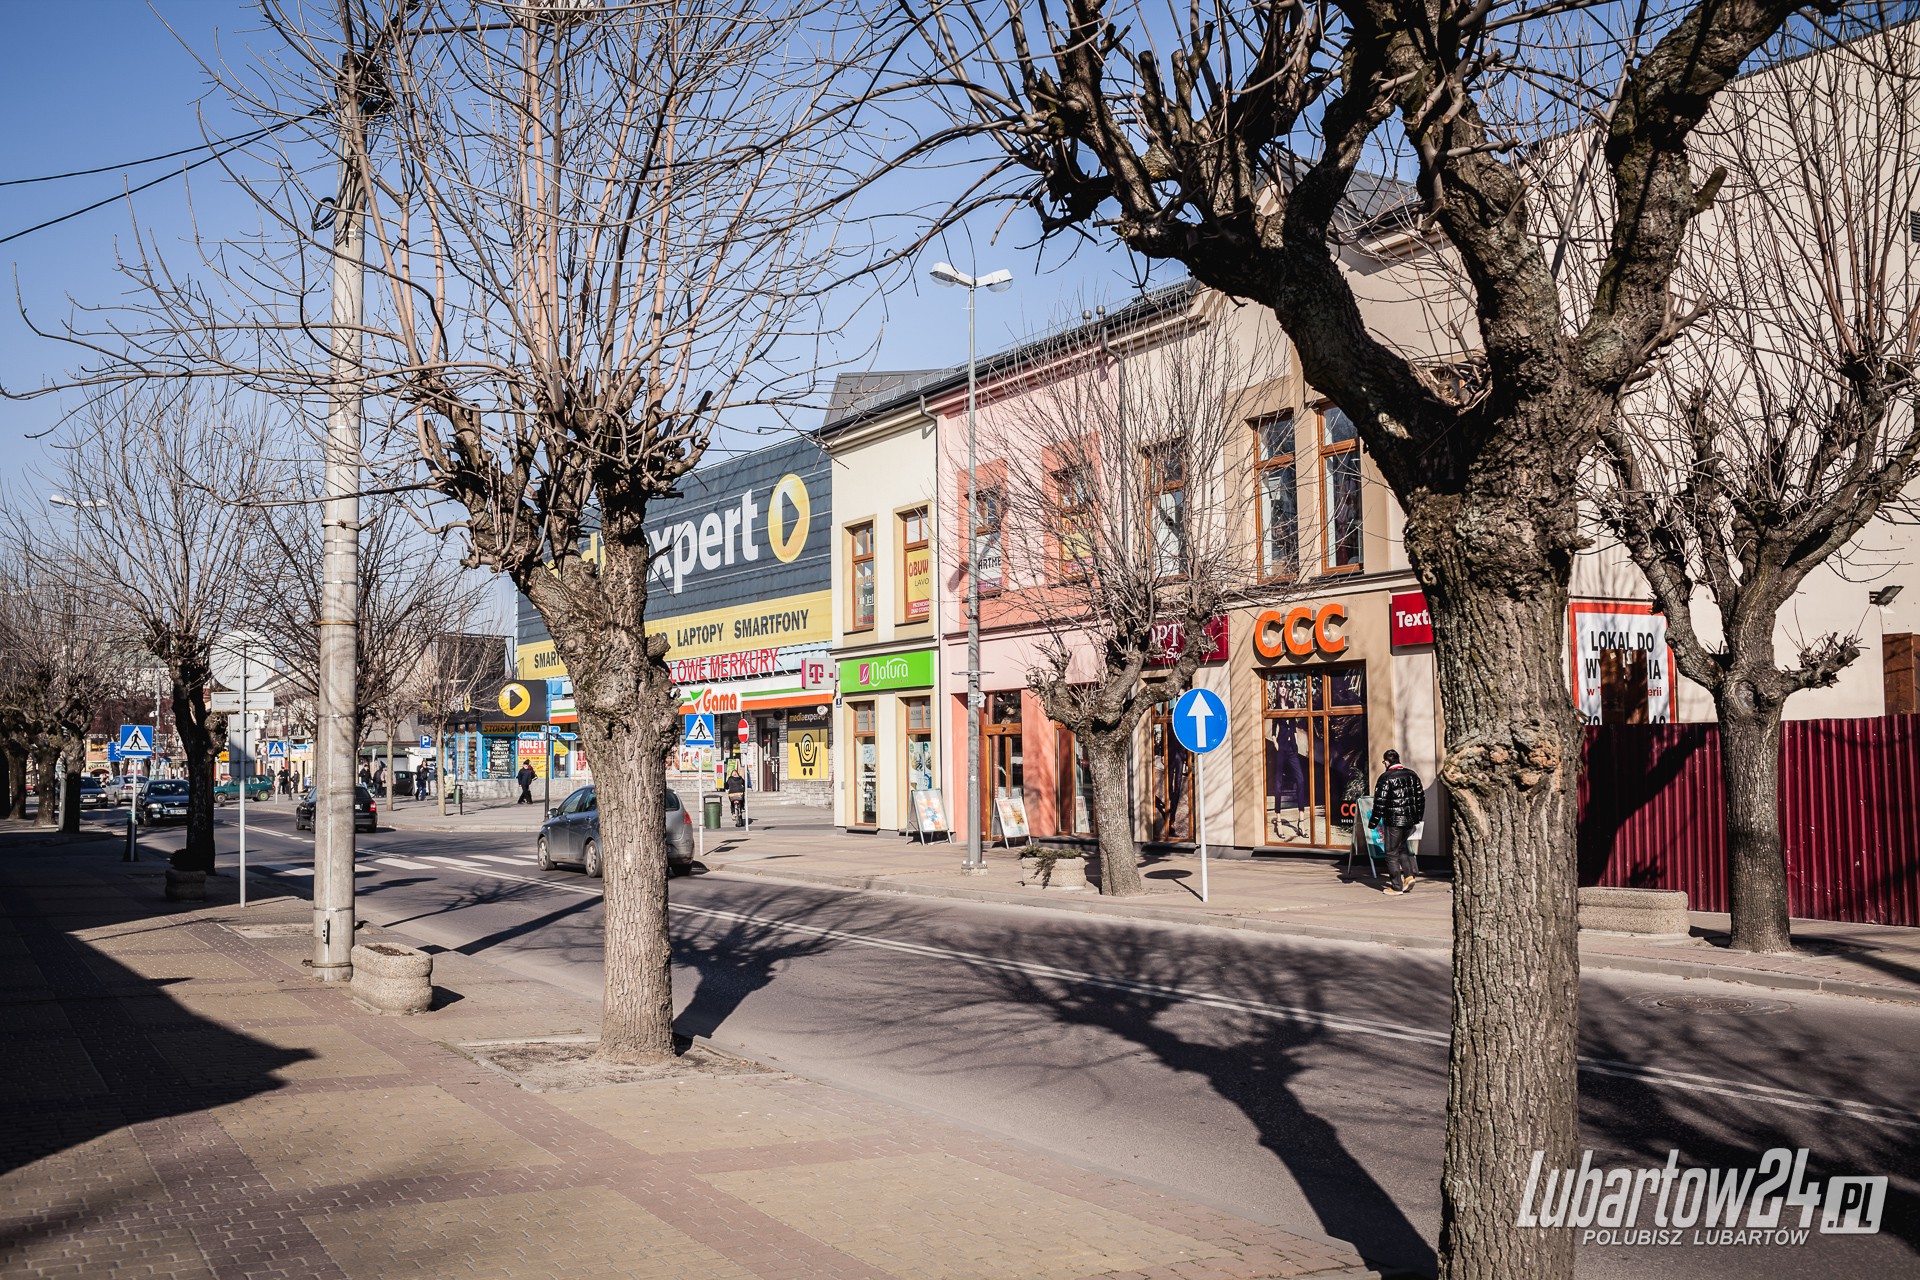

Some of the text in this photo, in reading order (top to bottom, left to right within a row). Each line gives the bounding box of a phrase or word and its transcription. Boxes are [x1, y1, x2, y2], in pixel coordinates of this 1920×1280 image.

[677, 622, 724, 648] LAPTOPY
[734, 608, 809, 639] SMARTFONY
[1254, 603, 1348, 658] CCC
[1590, 630, 1655, 652] LOKAL DO
[670, 646, 779, 684] LOWE MERKURY
[870, 657, 909, 687] Natura
[703, 688, 737, 712] Gama
[484, 725, 515, 733] STOISKA
[520, 740, 547, 749] ROLETY
